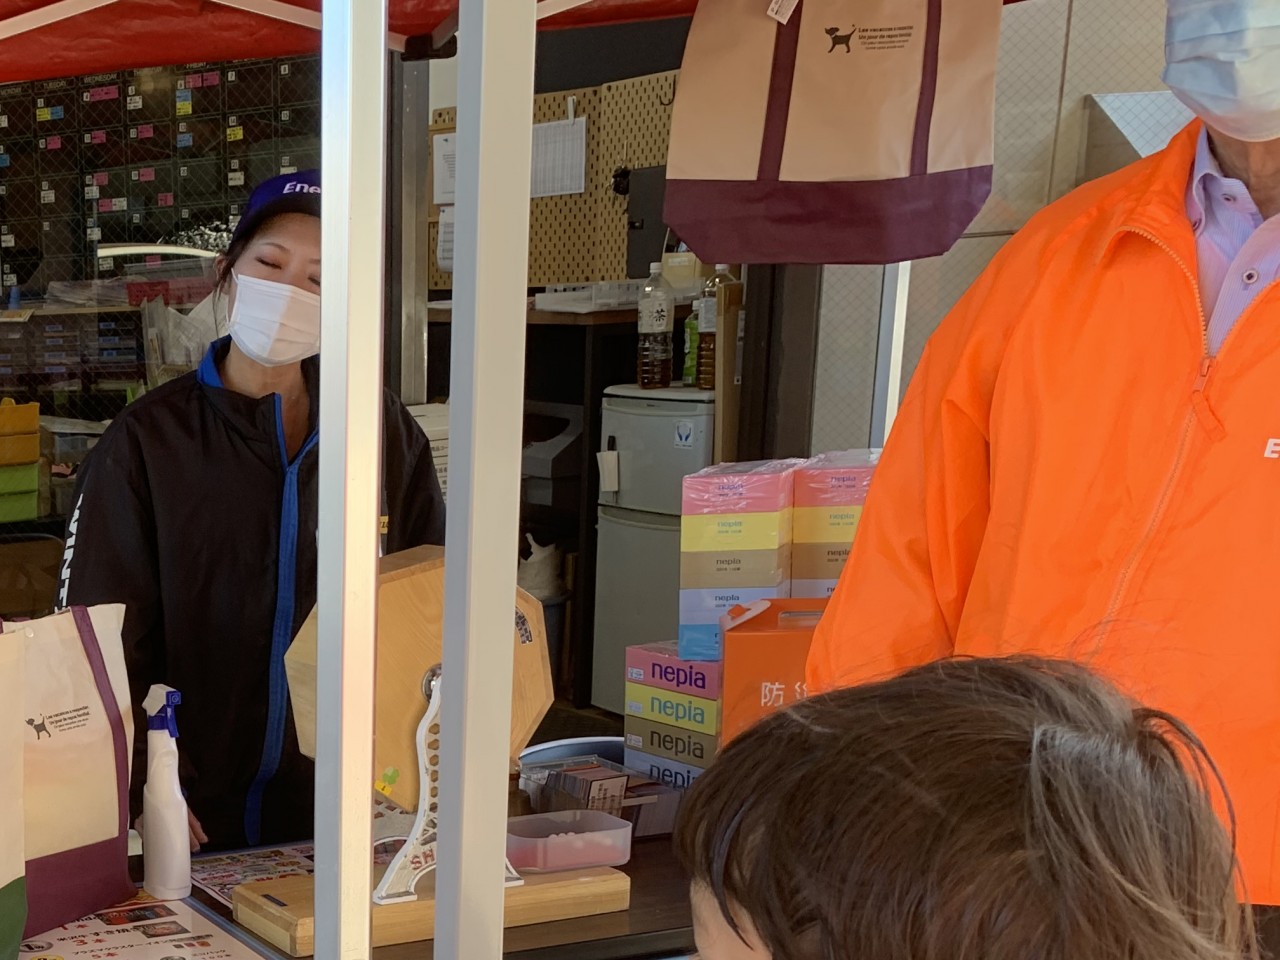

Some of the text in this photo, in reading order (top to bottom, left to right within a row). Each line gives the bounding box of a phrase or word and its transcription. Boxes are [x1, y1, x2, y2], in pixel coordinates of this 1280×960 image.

[716, 557, 741, 566] nepia
[715, 593, 740, 602] nepia
[651, 662, 706, 690] nepia
[650, 696, 705, 725] nepia
[650, 730, 704, 759] nepia
